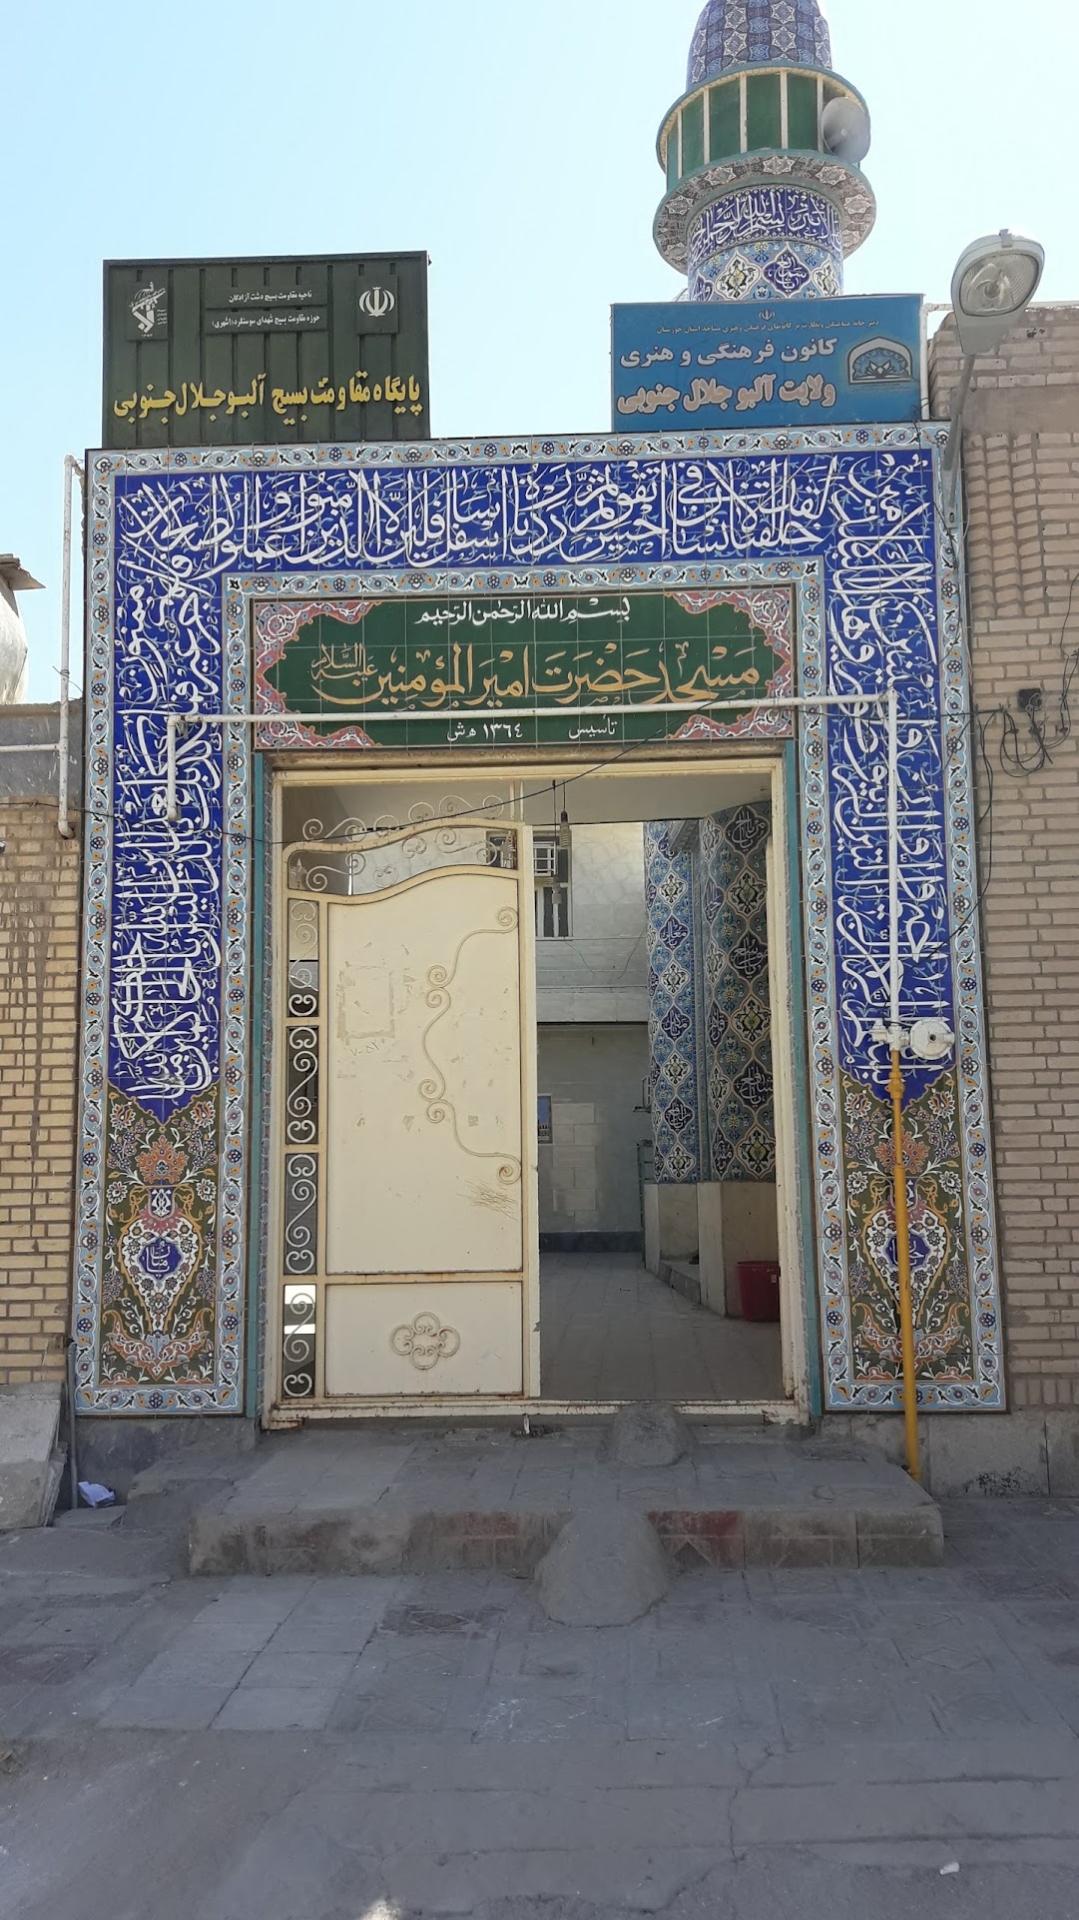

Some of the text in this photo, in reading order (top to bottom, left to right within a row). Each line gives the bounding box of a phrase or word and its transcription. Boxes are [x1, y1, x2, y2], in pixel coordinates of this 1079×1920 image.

[250, 291, 264, 301] دشت
[265, 294, 278, 302] بسیج
[278, 290, 298, 301] مقاومت
[256, 313, 274, 327] شهدای
[274, 317, 287, 326] بسیج
[287, 313, 306, 325] مقاومت
[306, 314, 320, 324] حوزه
[620, 338, 837, 368] کانون فرهنگی و هنری
[113, 382, 177, 424] جنوبی
[310, 370, 371, 411] مقاومت
[372, 374, 423, 417] پایگاه
[616, 382, 682, 415] جنوبی
[778, 373, 837, 409] ولایت
[271, 386, 309, 426] بسیج
[471, 599, 532, 627] الرحمن
[531, 598, 564, 621] الله
[560, 597, 631, 624] بسم
[310, 642, 367, 669] السلام
[531, 642, 661, 706] حضرت
[640, 643, 760, 705] مسجد
